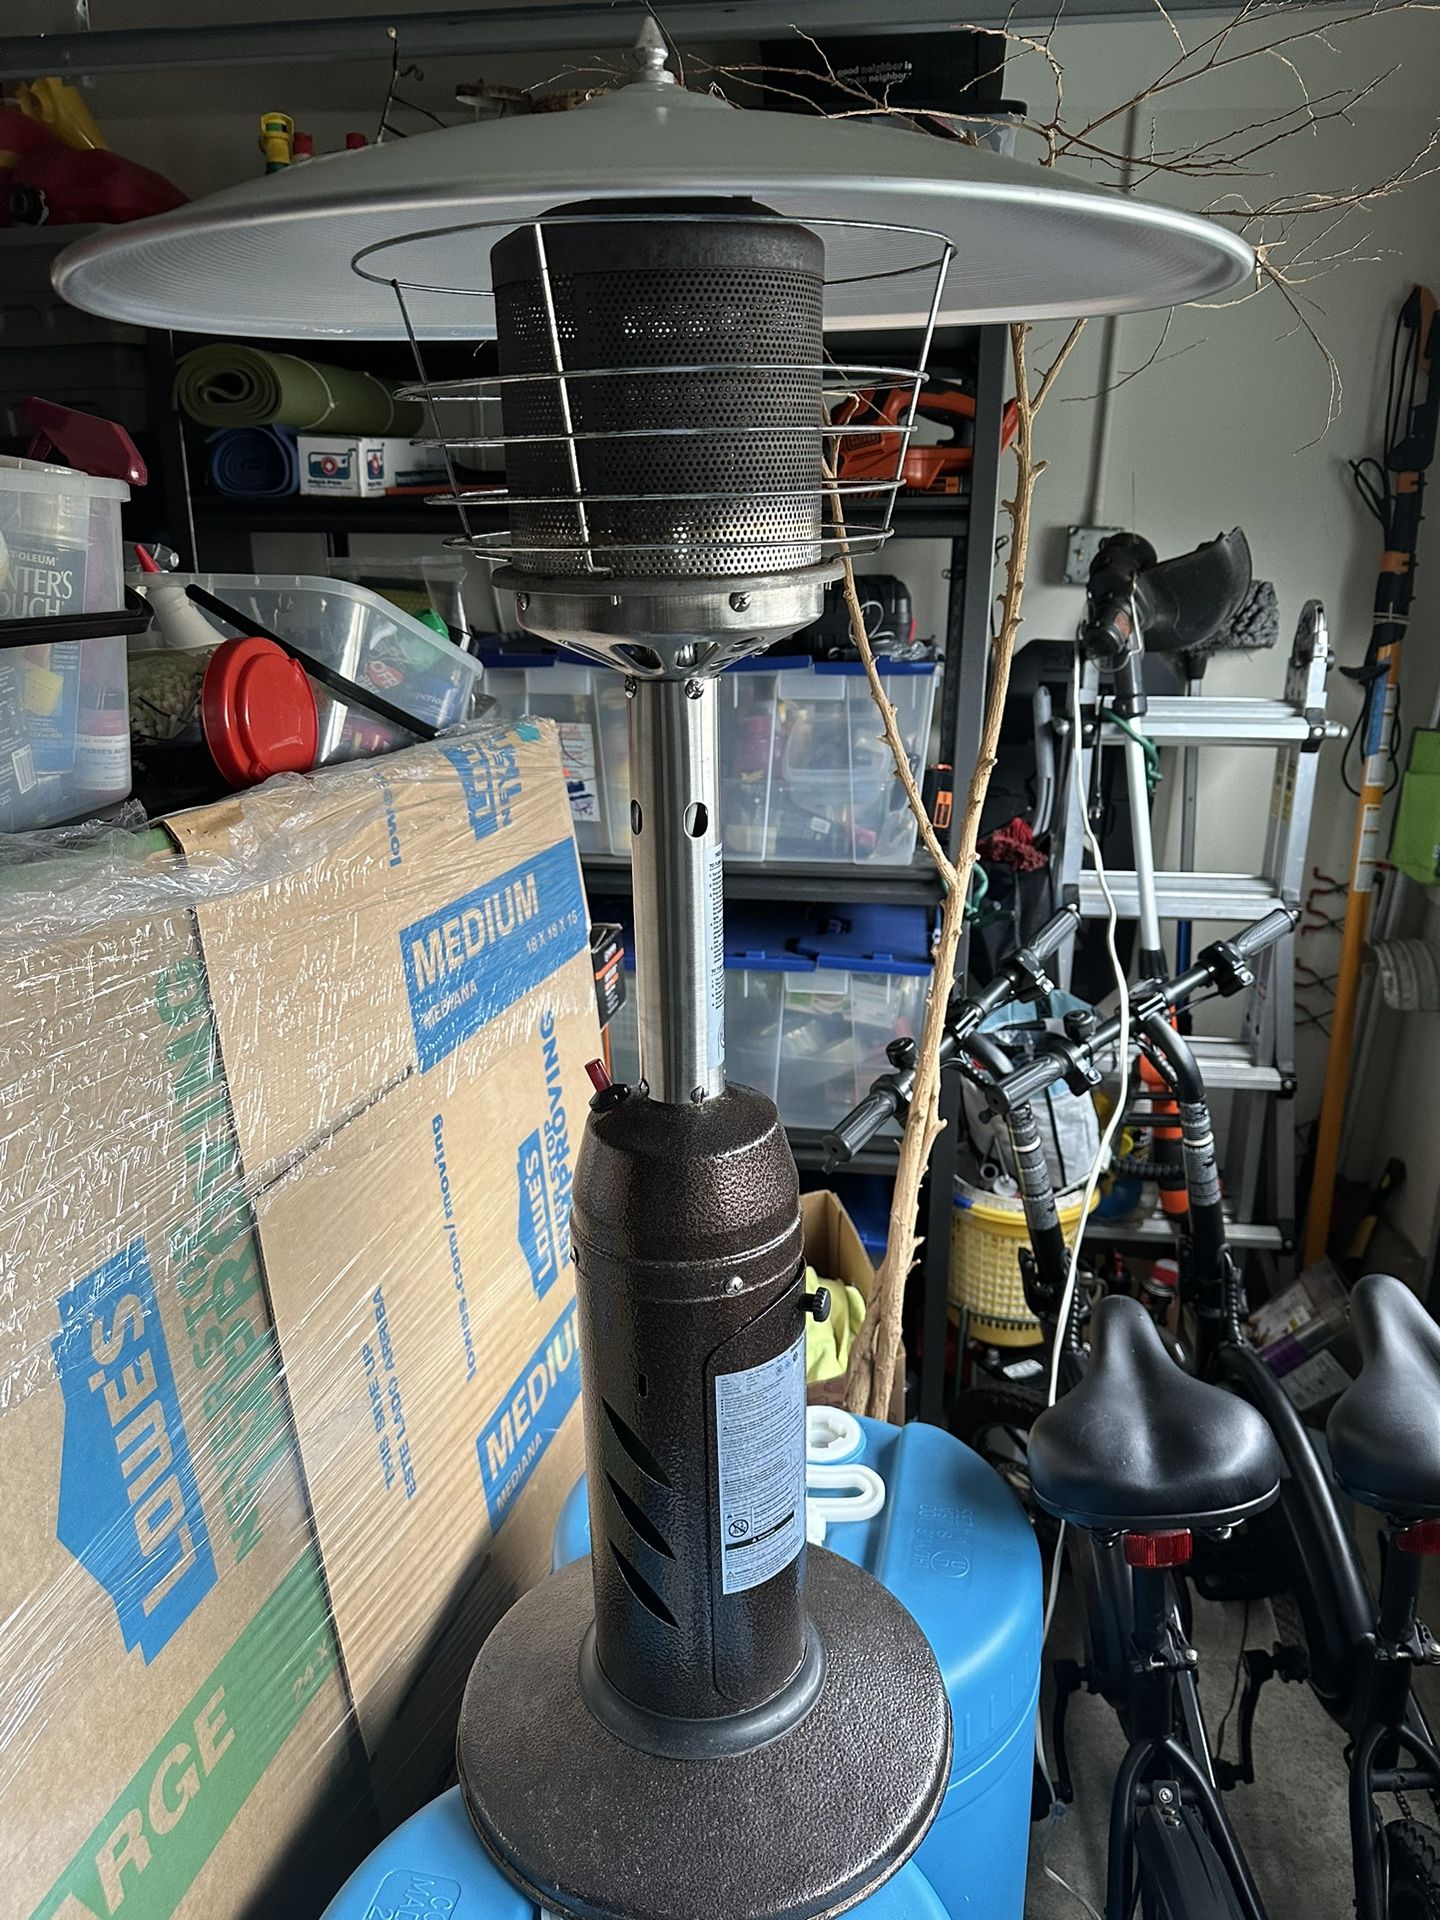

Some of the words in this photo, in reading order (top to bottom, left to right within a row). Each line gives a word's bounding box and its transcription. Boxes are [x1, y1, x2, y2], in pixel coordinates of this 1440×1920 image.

[411, 873, 540, 993] MEDIUM
[420, 979, 479, 1031] MEDIANA
[544, 1119, 559, 1184] STOP
[525, 1149, 552, 1282] LOWE'S
[362, 1342, 376, 1377] UP
[373, 1283, 395, 1372] ARRIBA
[368, 1377, 385, 1434] SIDE
[388, 1375, 406, 1440] LADO
[88, 1293, 197, 1617] LOWE'S
[379, 1434, 395, 1490] THIS
[399, 1438, 417, 1500] ESTE
[496, 1431, 543, 1508] MEDIANA
